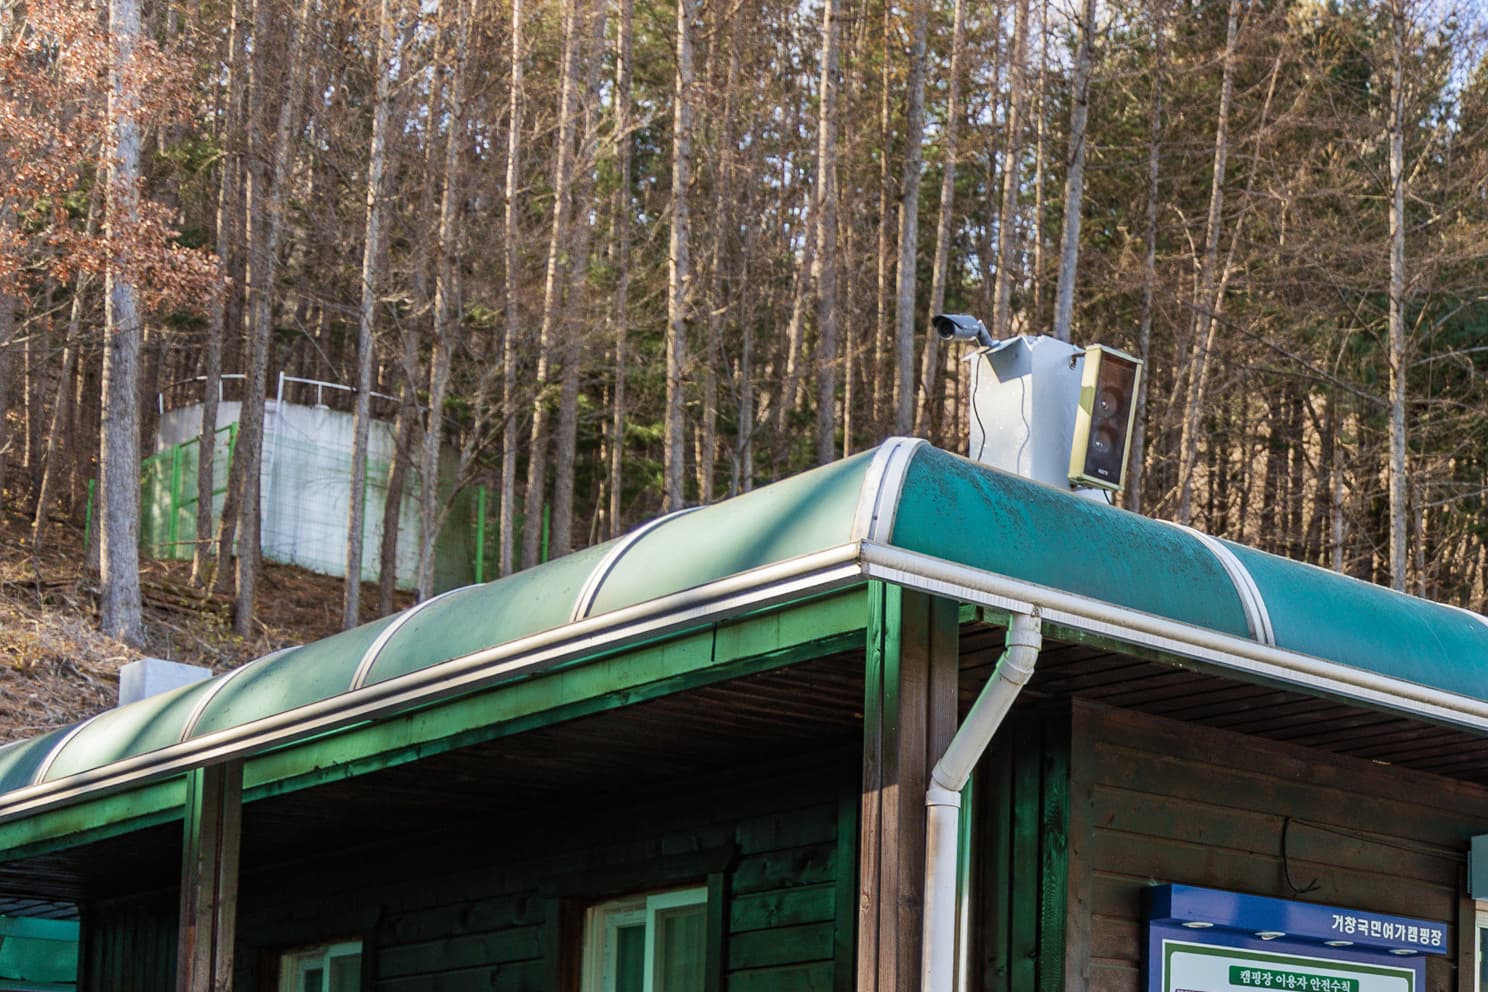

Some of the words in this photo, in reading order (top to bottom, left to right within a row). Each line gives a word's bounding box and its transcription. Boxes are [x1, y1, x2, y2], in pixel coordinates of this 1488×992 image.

[1332, 914, 1442, 946] 거창국민여가캠핑장
[1240, 970, 1273, 986] 캠핑장
[1275, 974, 1308, 990] 이용자
